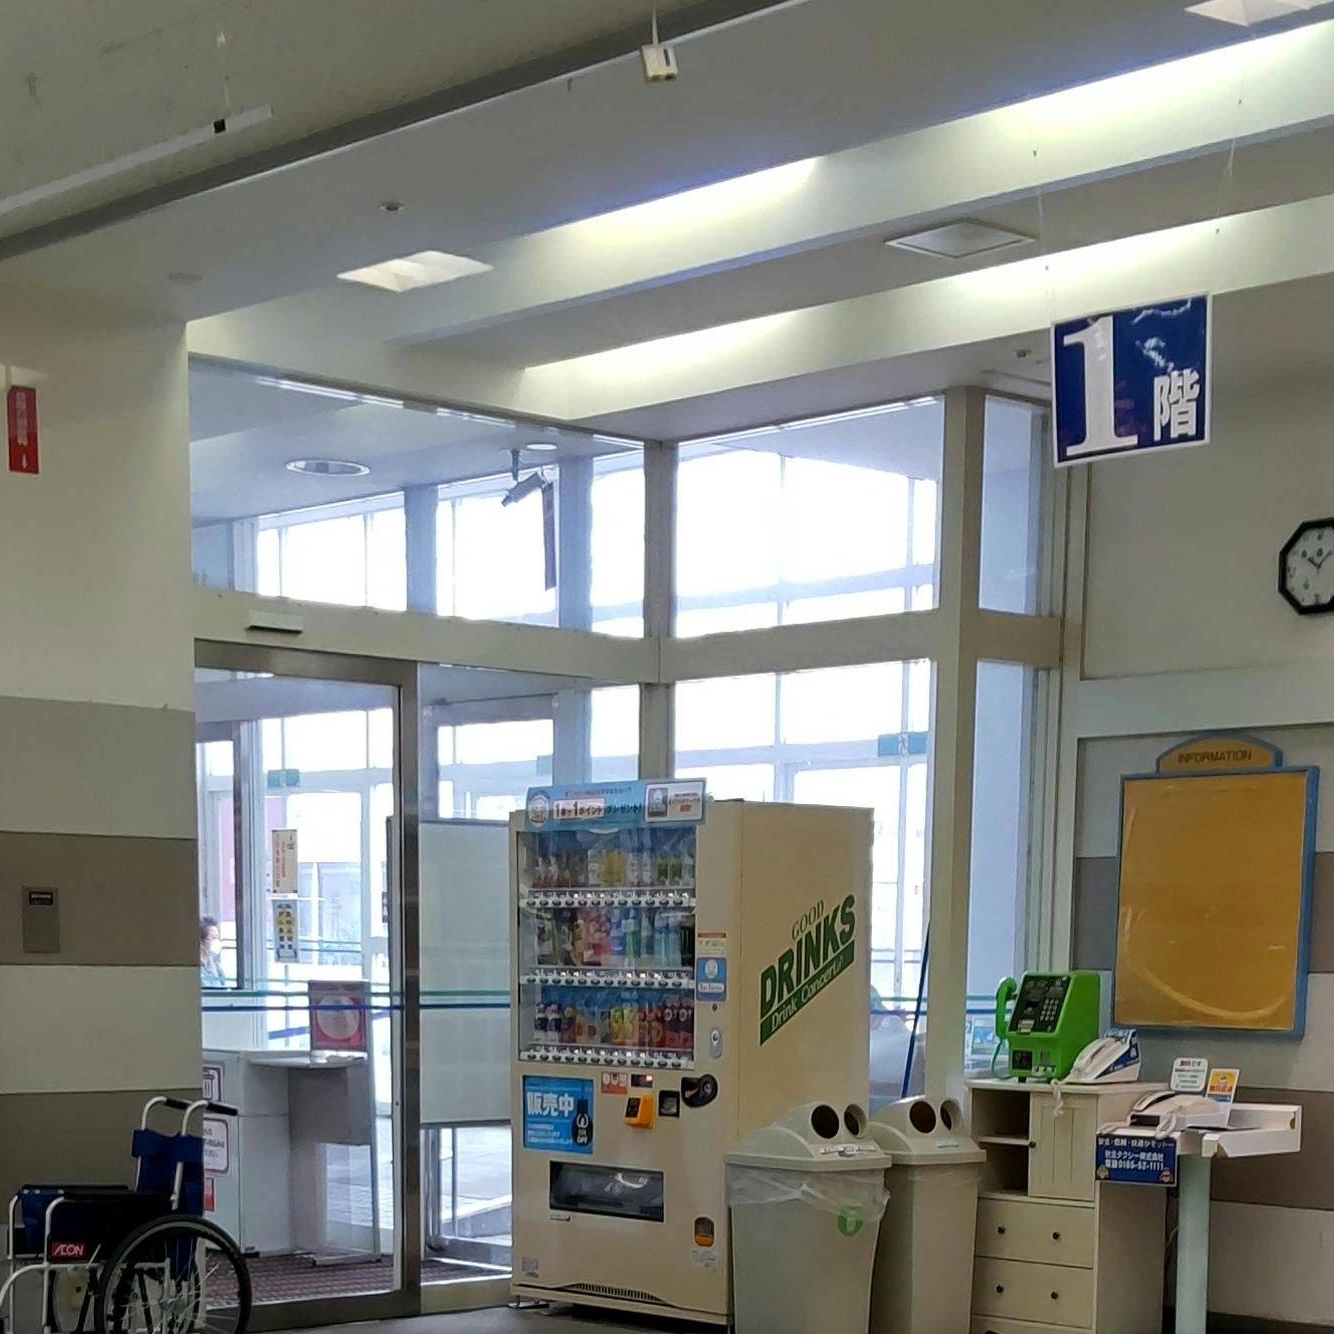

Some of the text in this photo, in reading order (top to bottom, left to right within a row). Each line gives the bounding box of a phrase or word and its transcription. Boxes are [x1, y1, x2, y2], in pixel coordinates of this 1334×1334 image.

[1063, 314, 1201, 457] 1階
[1178, 750, 1252, 763] INFORMATION
[791, 899, 825, 941] GOOD
[760, 894, 856, 1020] DRINKS
[771, 998, 798, 1031] Drink
[527, 1091, 574, 1117] 販売中
